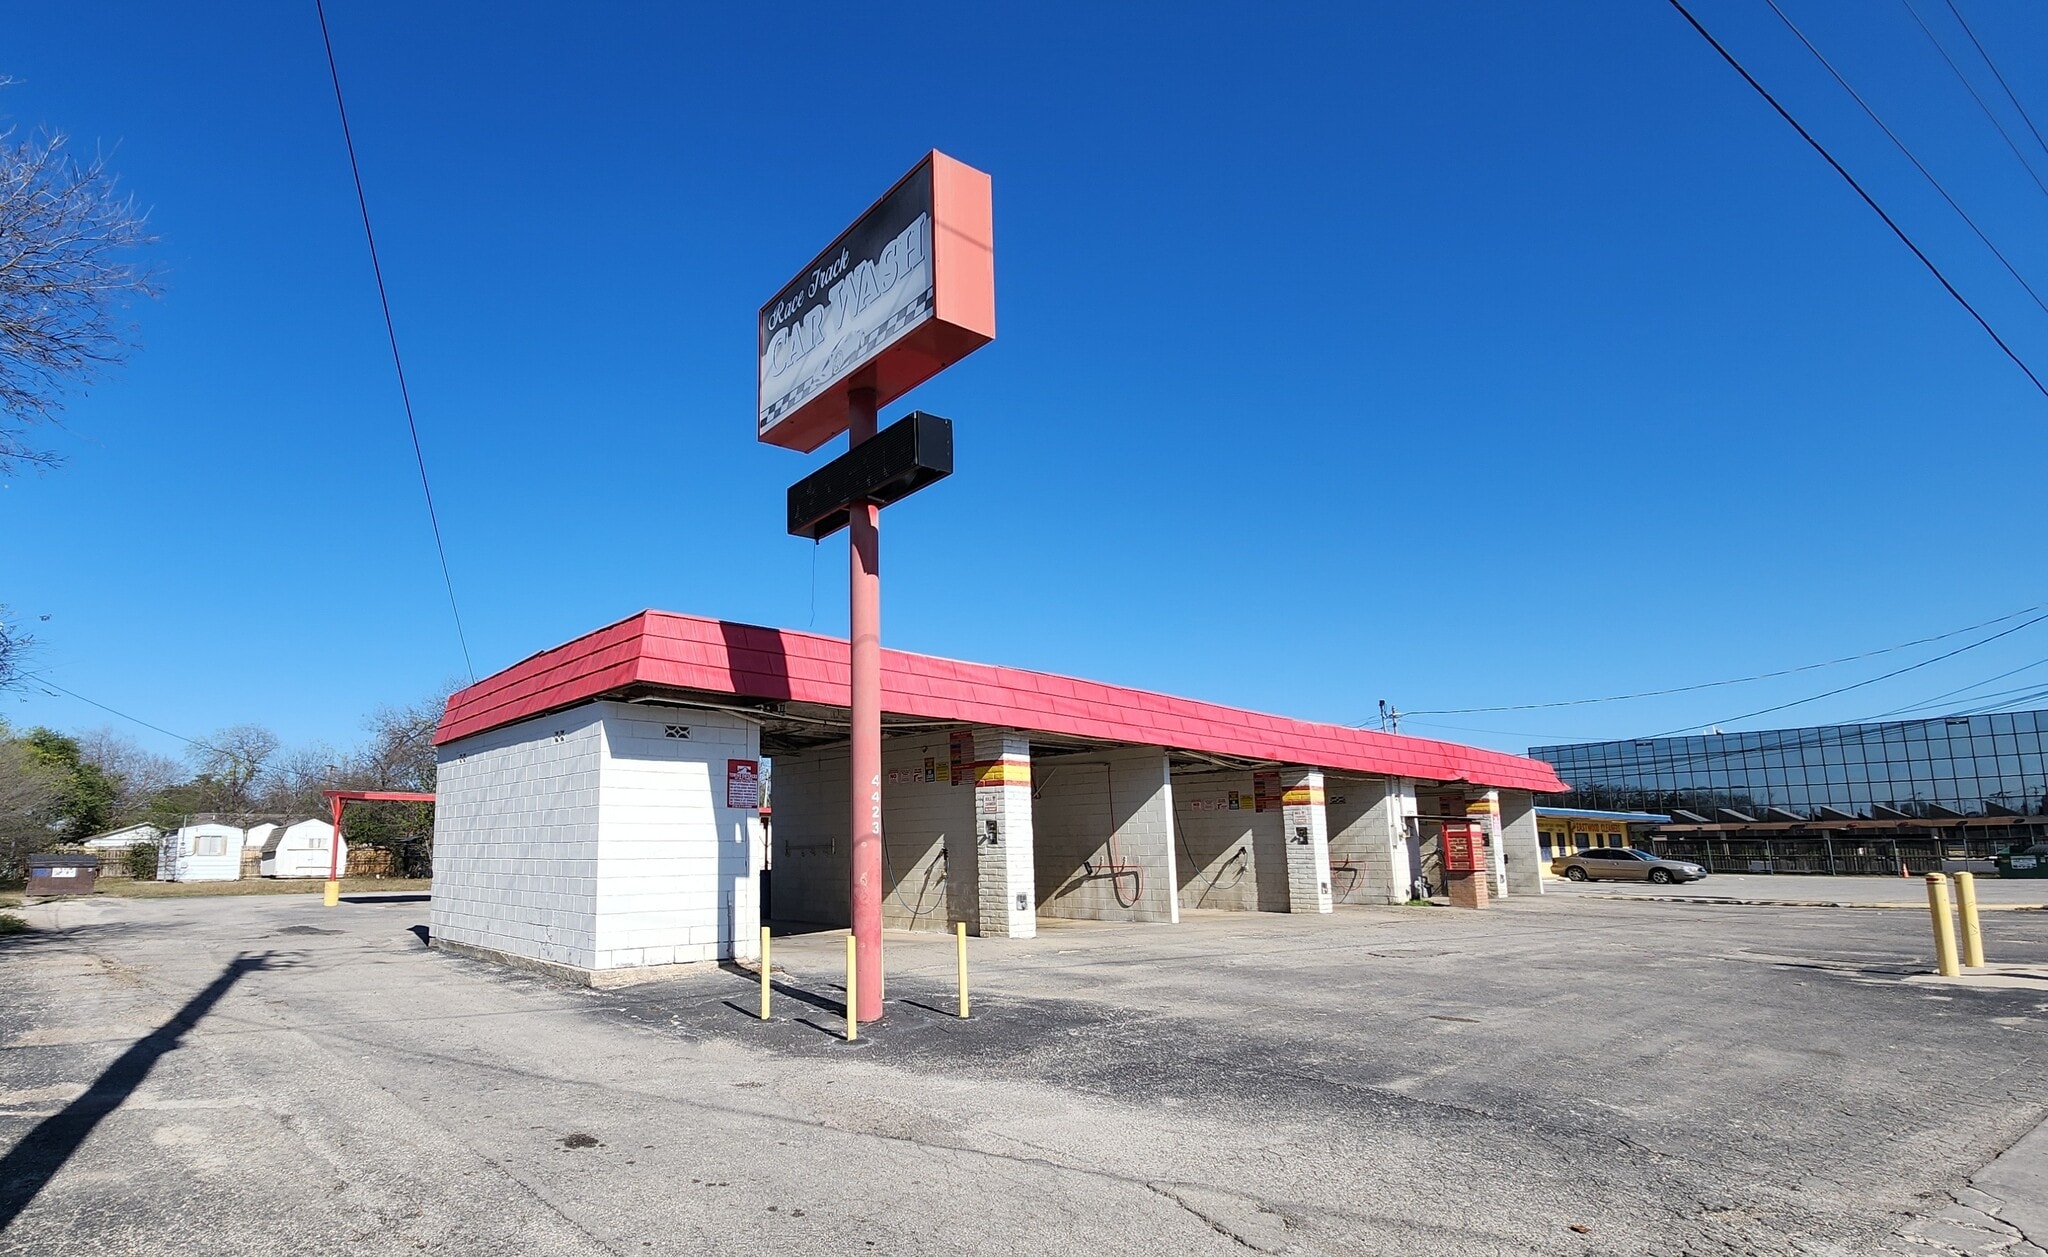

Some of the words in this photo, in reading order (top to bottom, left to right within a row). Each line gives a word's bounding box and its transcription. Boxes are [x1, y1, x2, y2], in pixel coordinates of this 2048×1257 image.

[766, 304, 827, 378] CAR
[828, 211, 928, 330] WASH
[768, 291, 805, 331] Race
[808, 248, 850, 298] Track
[871, 774, 881, 834] 4423
[1576, 822, 1600, 832] EASTWOOD
